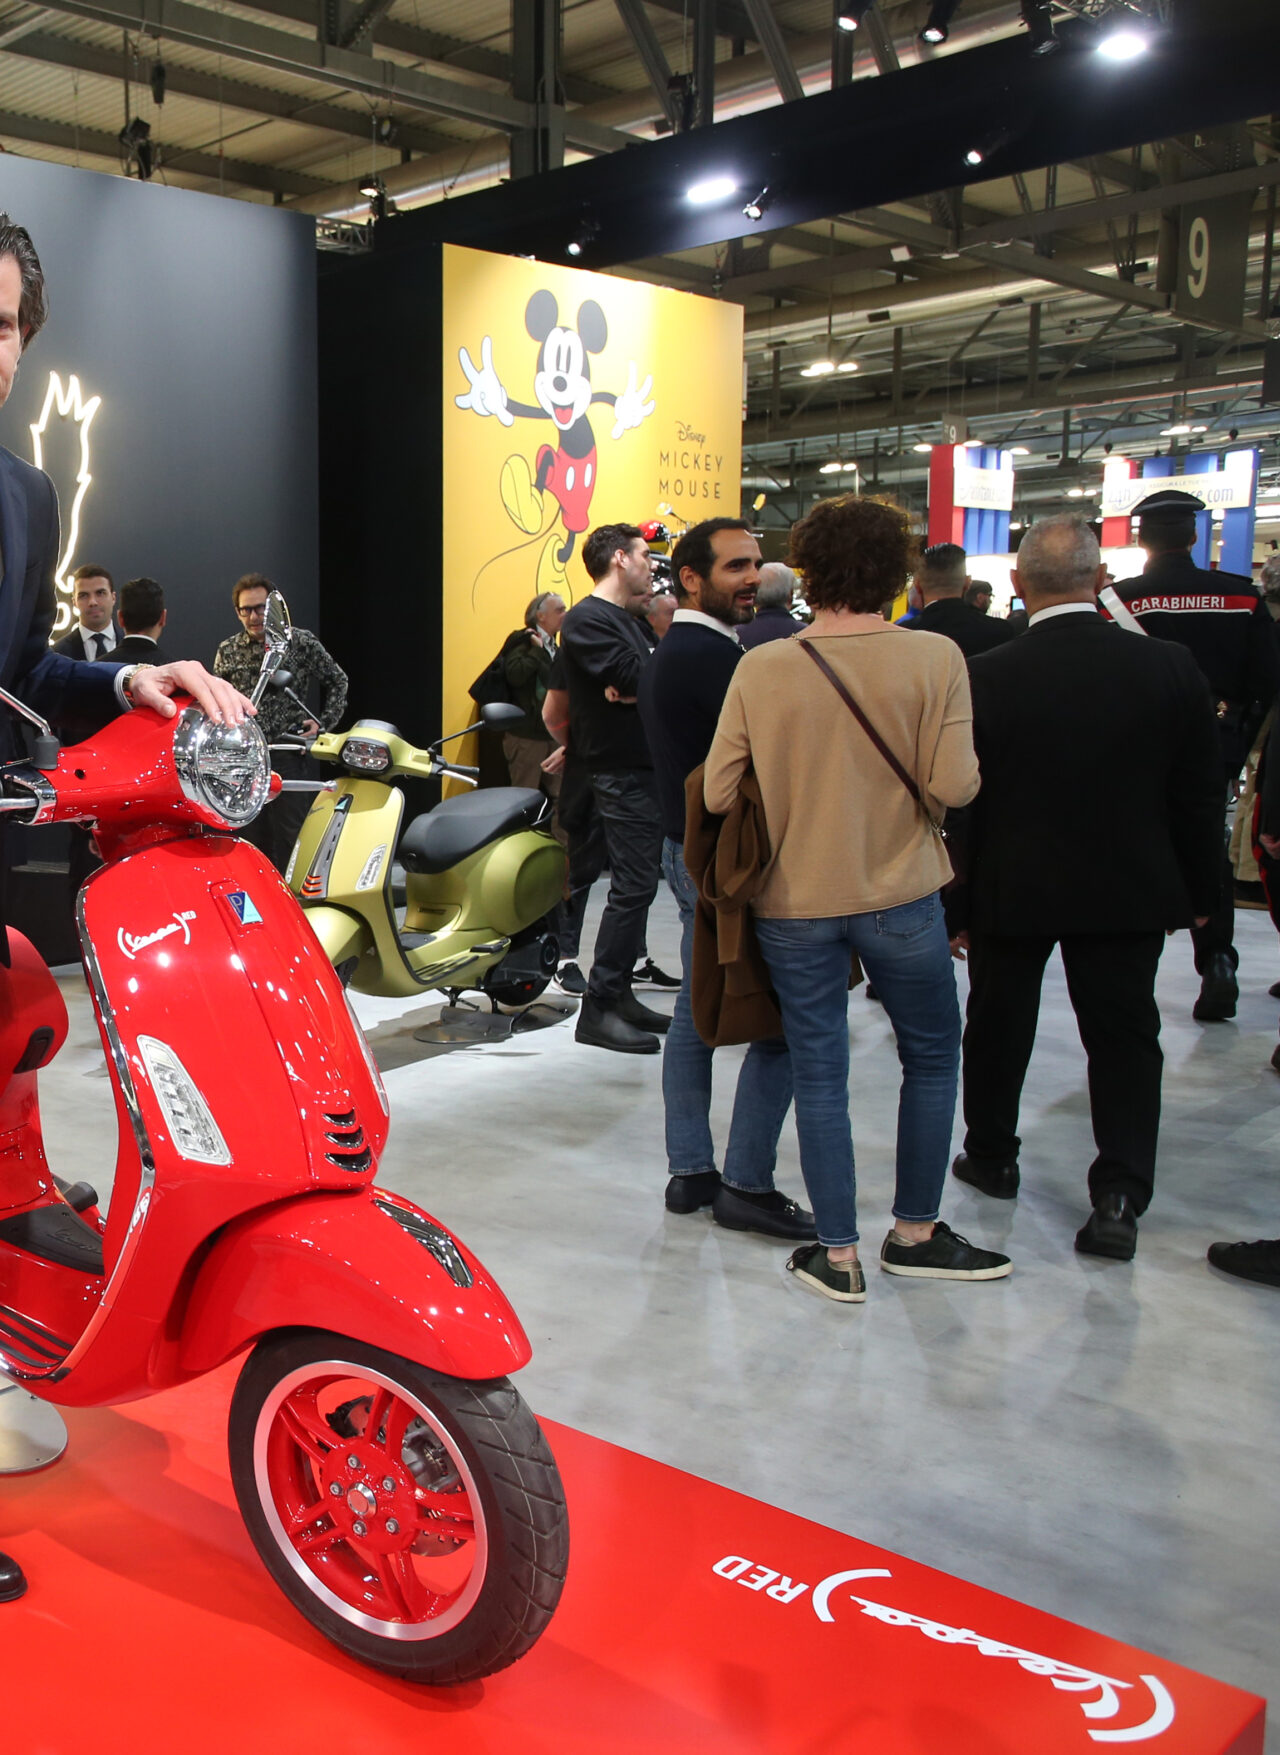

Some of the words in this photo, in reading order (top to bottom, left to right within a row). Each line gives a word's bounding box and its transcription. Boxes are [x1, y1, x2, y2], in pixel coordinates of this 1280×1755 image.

[1187, 216, 1210, 299] 9
[660, 450, 723, 473] MICKEY
[659, 478, 721, 499] MOUSE
[1131, 596, 1225, 613] CARABINIERI
[712, 1555, 809, 1604] RED
